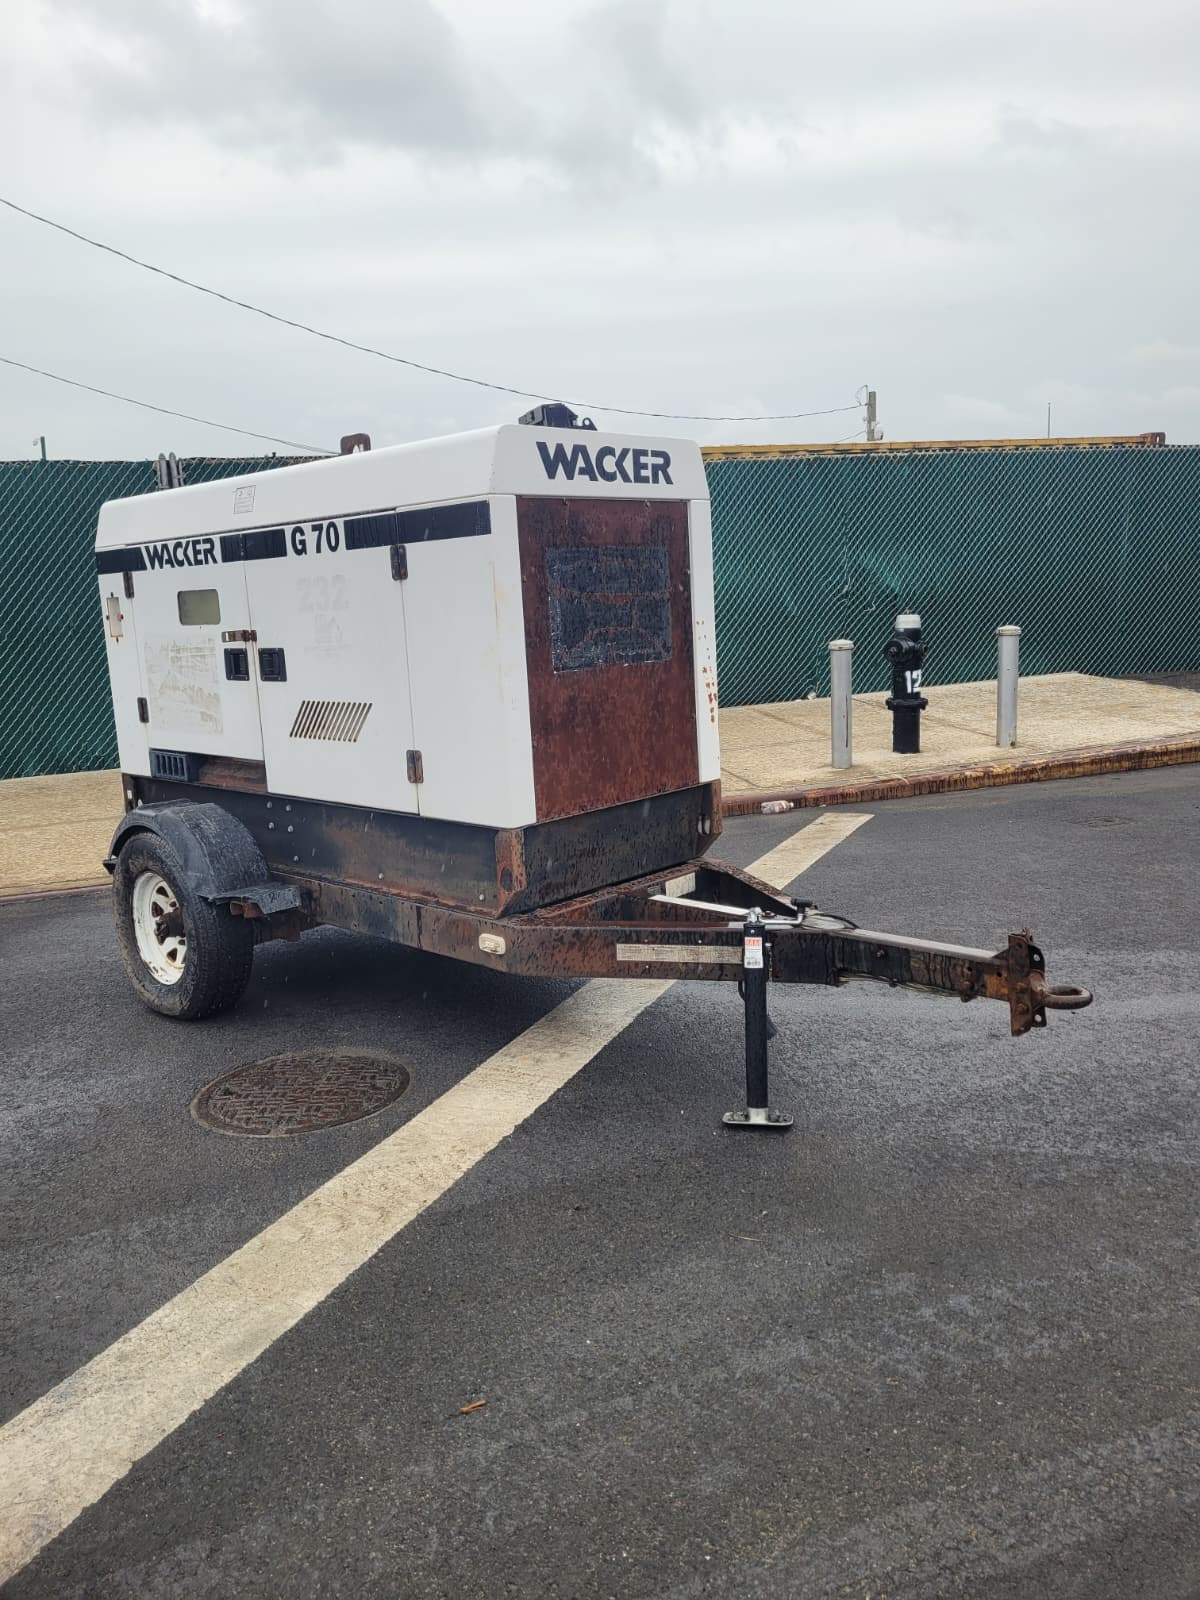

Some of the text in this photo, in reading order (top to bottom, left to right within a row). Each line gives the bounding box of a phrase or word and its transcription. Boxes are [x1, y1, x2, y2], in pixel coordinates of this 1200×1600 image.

[536, 441, 674, 485] WACKER
[145, 537, 217, 569] WACKER
[290, 521, 340, 557] G 70
[905, 668, 922, 694] 12
